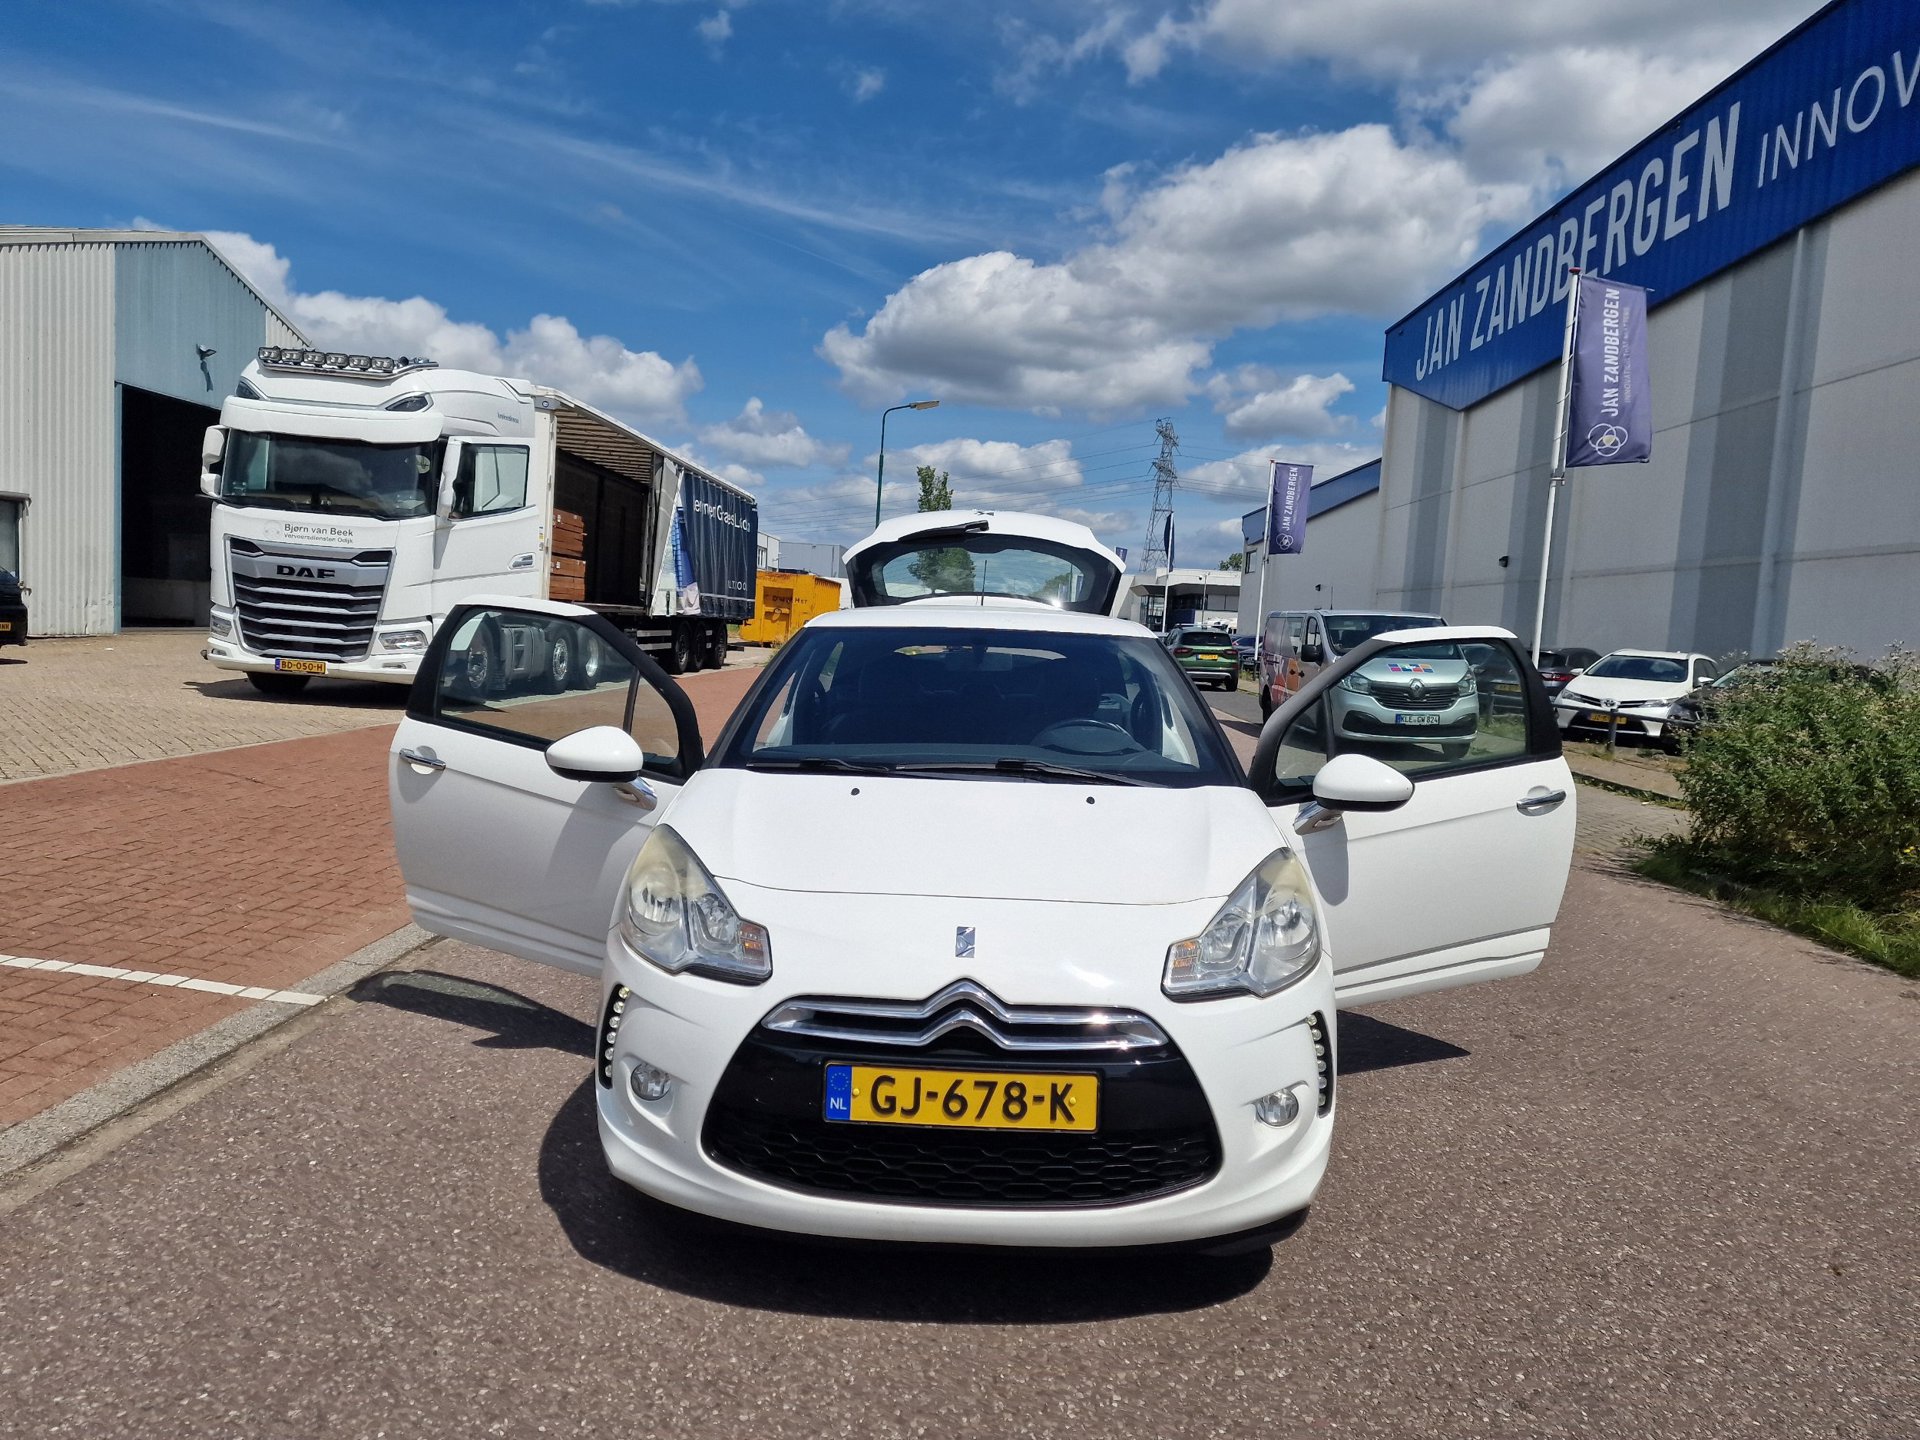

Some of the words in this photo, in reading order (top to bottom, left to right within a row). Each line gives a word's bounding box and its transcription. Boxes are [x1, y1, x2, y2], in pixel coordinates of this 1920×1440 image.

[1415, 293, 1465, 382] JAN
[1469, 101, 1741, 352] ZANDBERGEN
[1757, 46, 1920, 188] INNOV
[1603, 288, 1620, 383] ZANDBERGEN
[1600, 388, 1619, 417] JAN
[1284, 467, 1299, 515] ZANDBERGEN
[284, 523, 309, 533] Bjørn
[330, 528, 354, 537] Beek
[1282, 516, 1291, 531] JAN
[276, 564, 336, 579] DAF
[281, 661, 323, 671] BD-050-H
[829, 1097, 848, 1110] NL
[870, 1074, 1076, 1123] GJ-678-K
